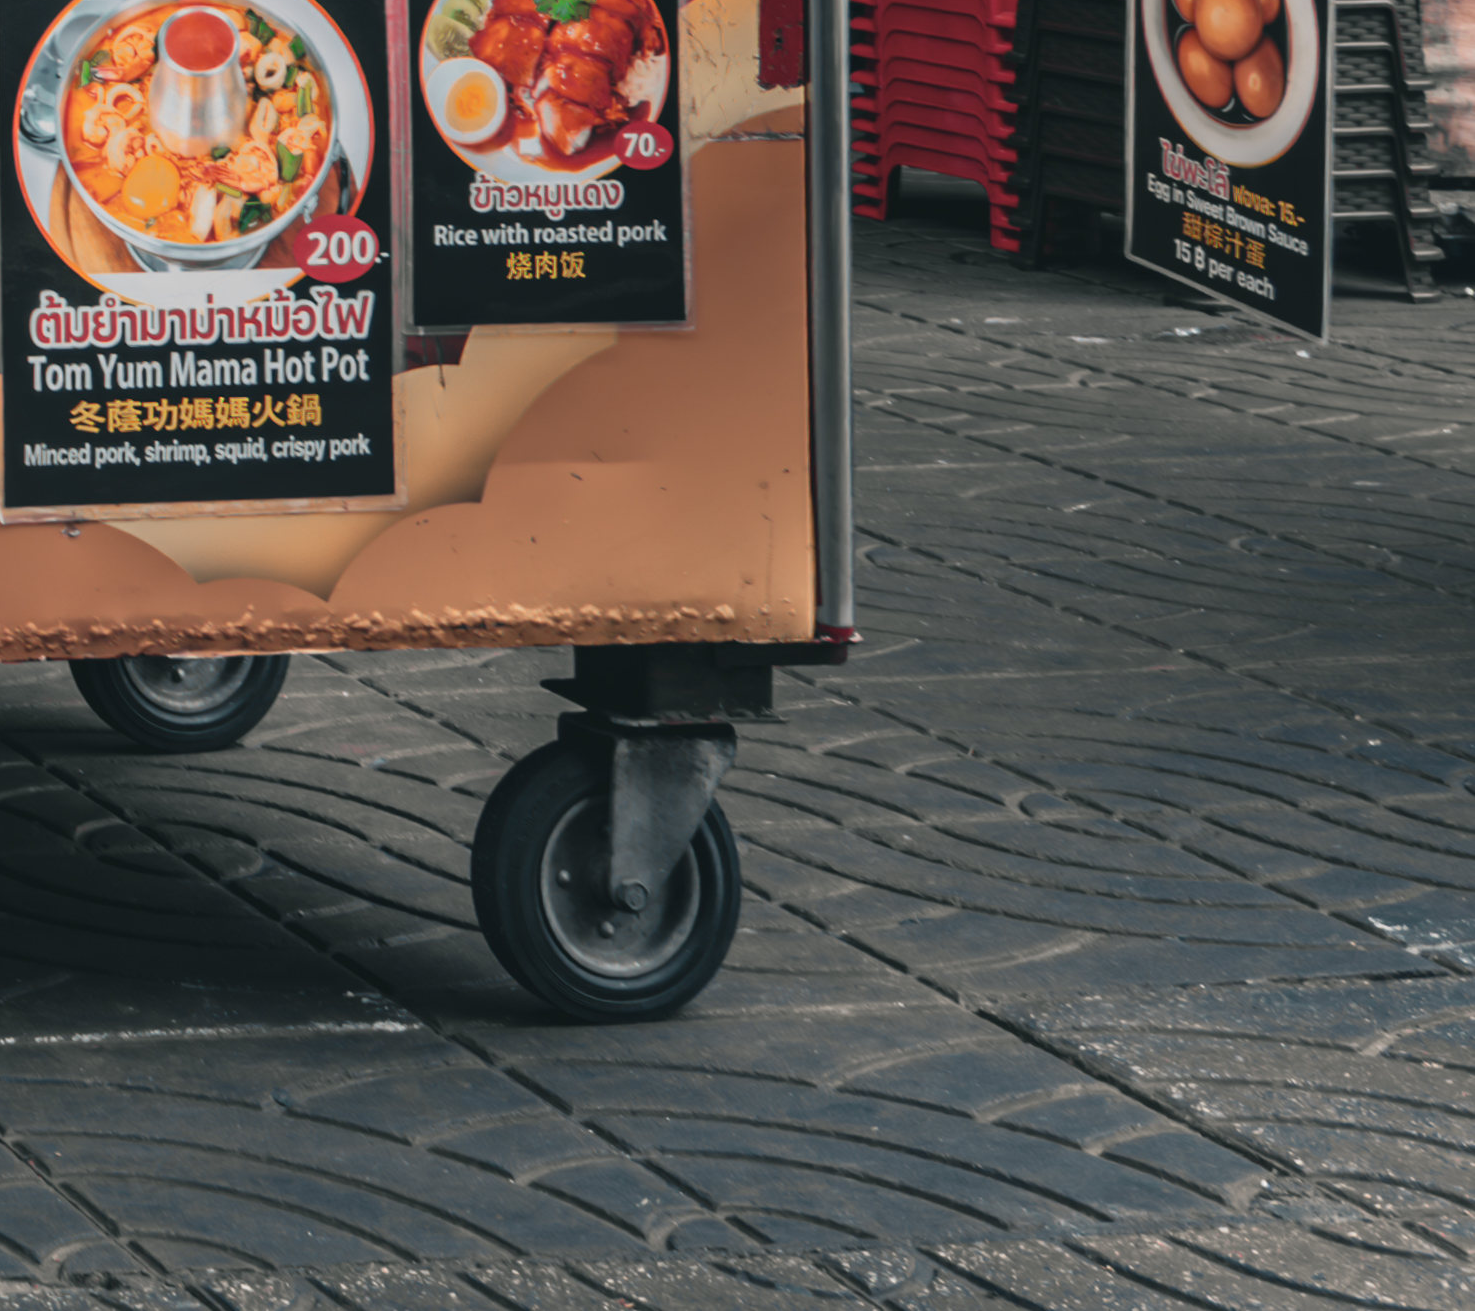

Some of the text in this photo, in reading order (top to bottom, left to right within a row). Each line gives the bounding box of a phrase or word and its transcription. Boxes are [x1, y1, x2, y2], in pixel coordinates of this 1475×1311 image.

[1148, 173, 1309, 256] Egg in Sweet Brown Sauce
[27, 347, 369, 391] Tom Yum Mama Hot Pot
[24, 433, 371, 468] Minced pork, shrimp, squid, crispy pork
